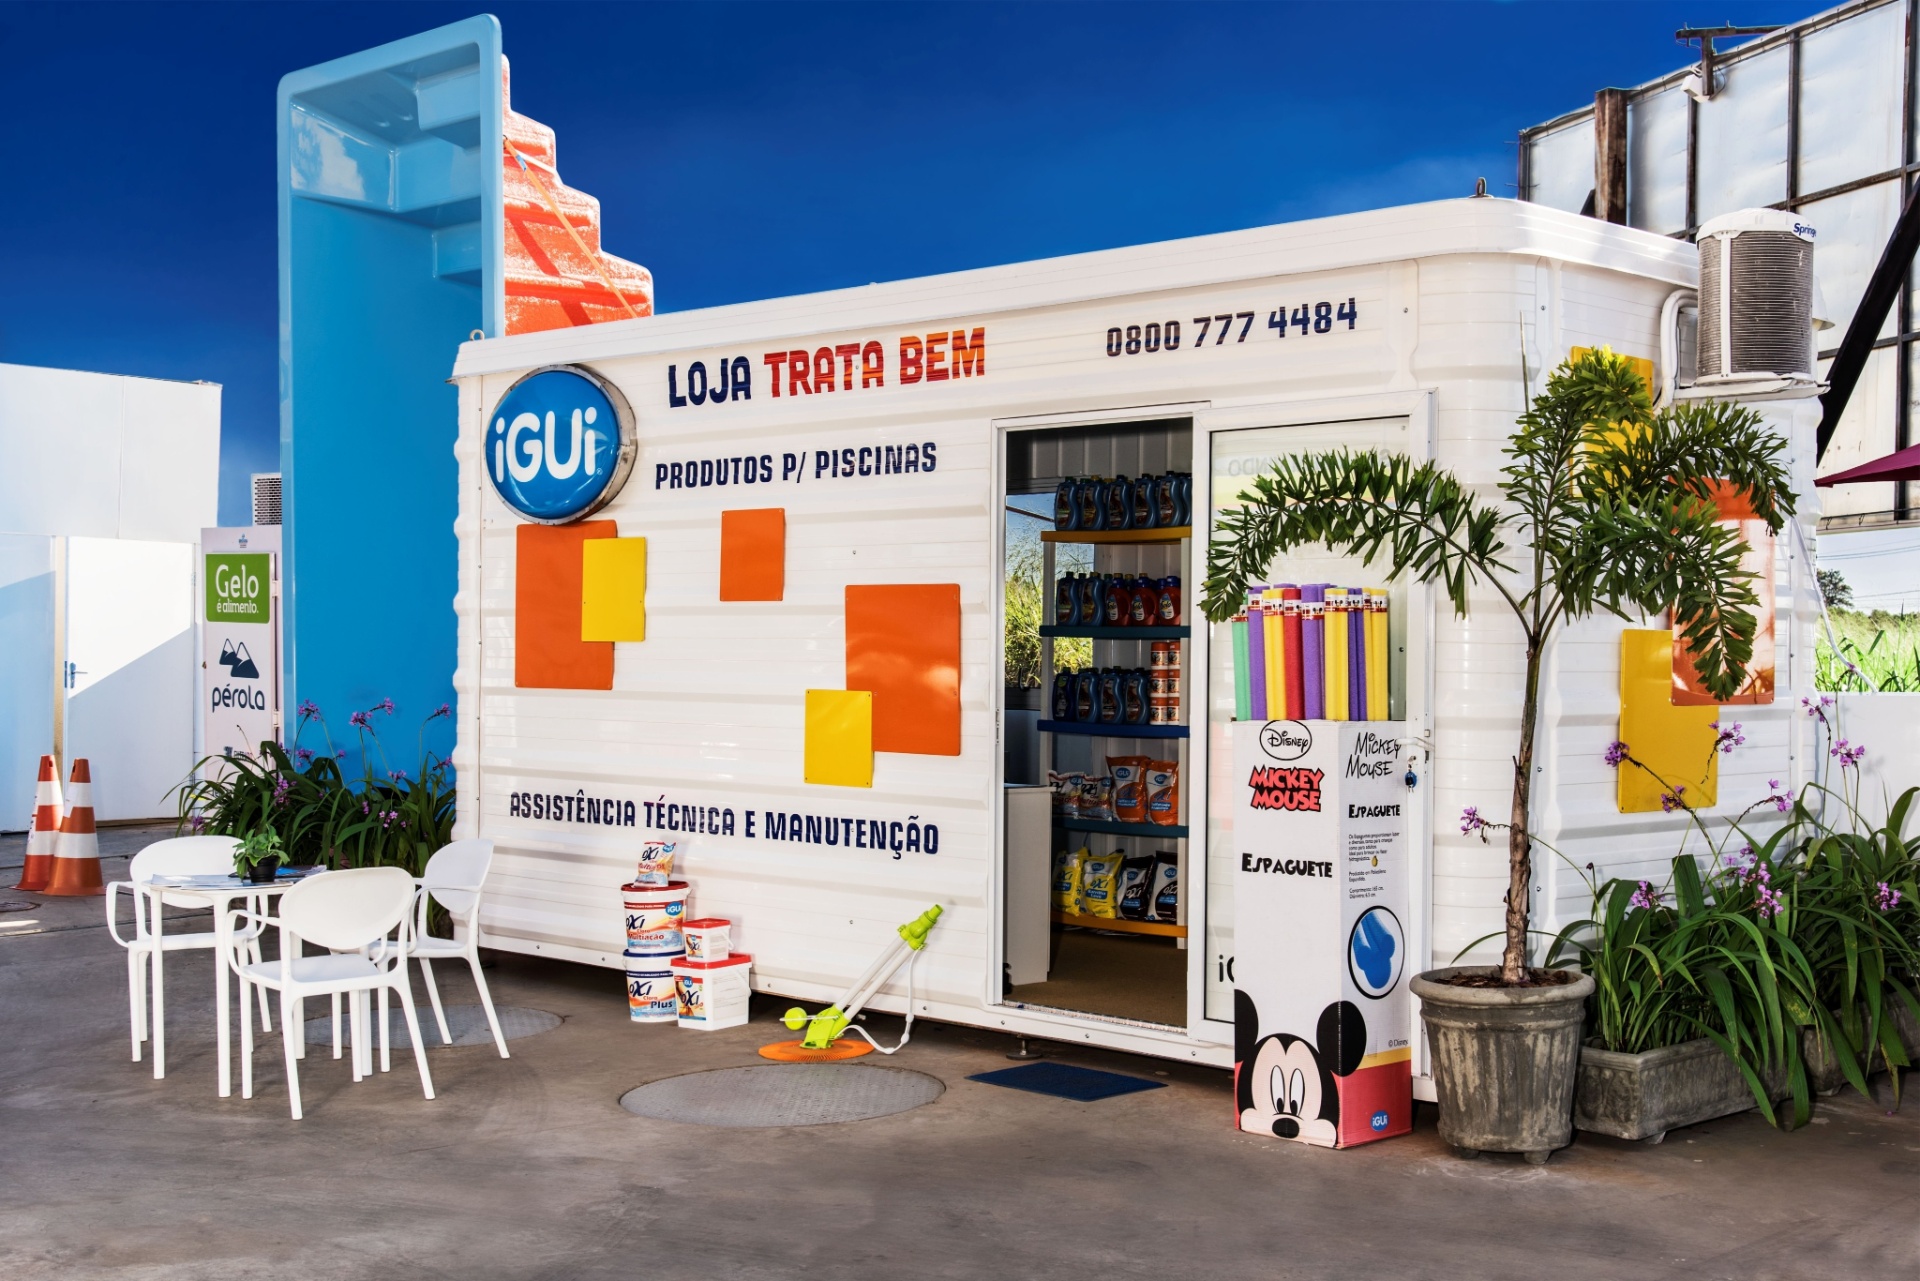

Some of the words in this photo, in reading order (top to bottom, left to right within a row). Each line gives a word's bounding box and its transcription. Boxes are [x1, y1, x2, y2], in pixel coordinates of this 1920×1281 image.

[1107, 320, 1181, 357] 0800
[1193, 310, 1255, 348] 777
[1268, 297, 1358, 338] 4484
[667, 355, 752, 408] LOJA
[763, 340, 884, 398] TRATA
[899, 326, 985, 385] BEM
[495, 406, 600, 484] iGUi
[654, 453, 772, 490] PRODUTOS
[782, 451, 806, 484] P/
[815, 441, 937, 479] PISCINAS
[215, 563, 260, 598] Gelo
[217, 599, 222, 613] é
[212, 683, 265, 713] pérola
[1264, 728, 1309, 753] Disney
[1248, 764, 1325, 790] MICKEY
[1250, 789, 1321, 812] MOUSE
[1349, 804, 1401, 818] ESPAGUETE
[510, 789, 636, 828] ASSISTÊNCIA
[644, 794, 735, 836] TÉCNICA
[745, 810, 756, 839] E
[765, 811, 940, 860] MANUTENÇÃO
[1241, 853, 1333, 878] ESPAGUETE
[651, 1001, 673, 1009] Plus
[1372, 1114, 1388, 1127] iGUi
